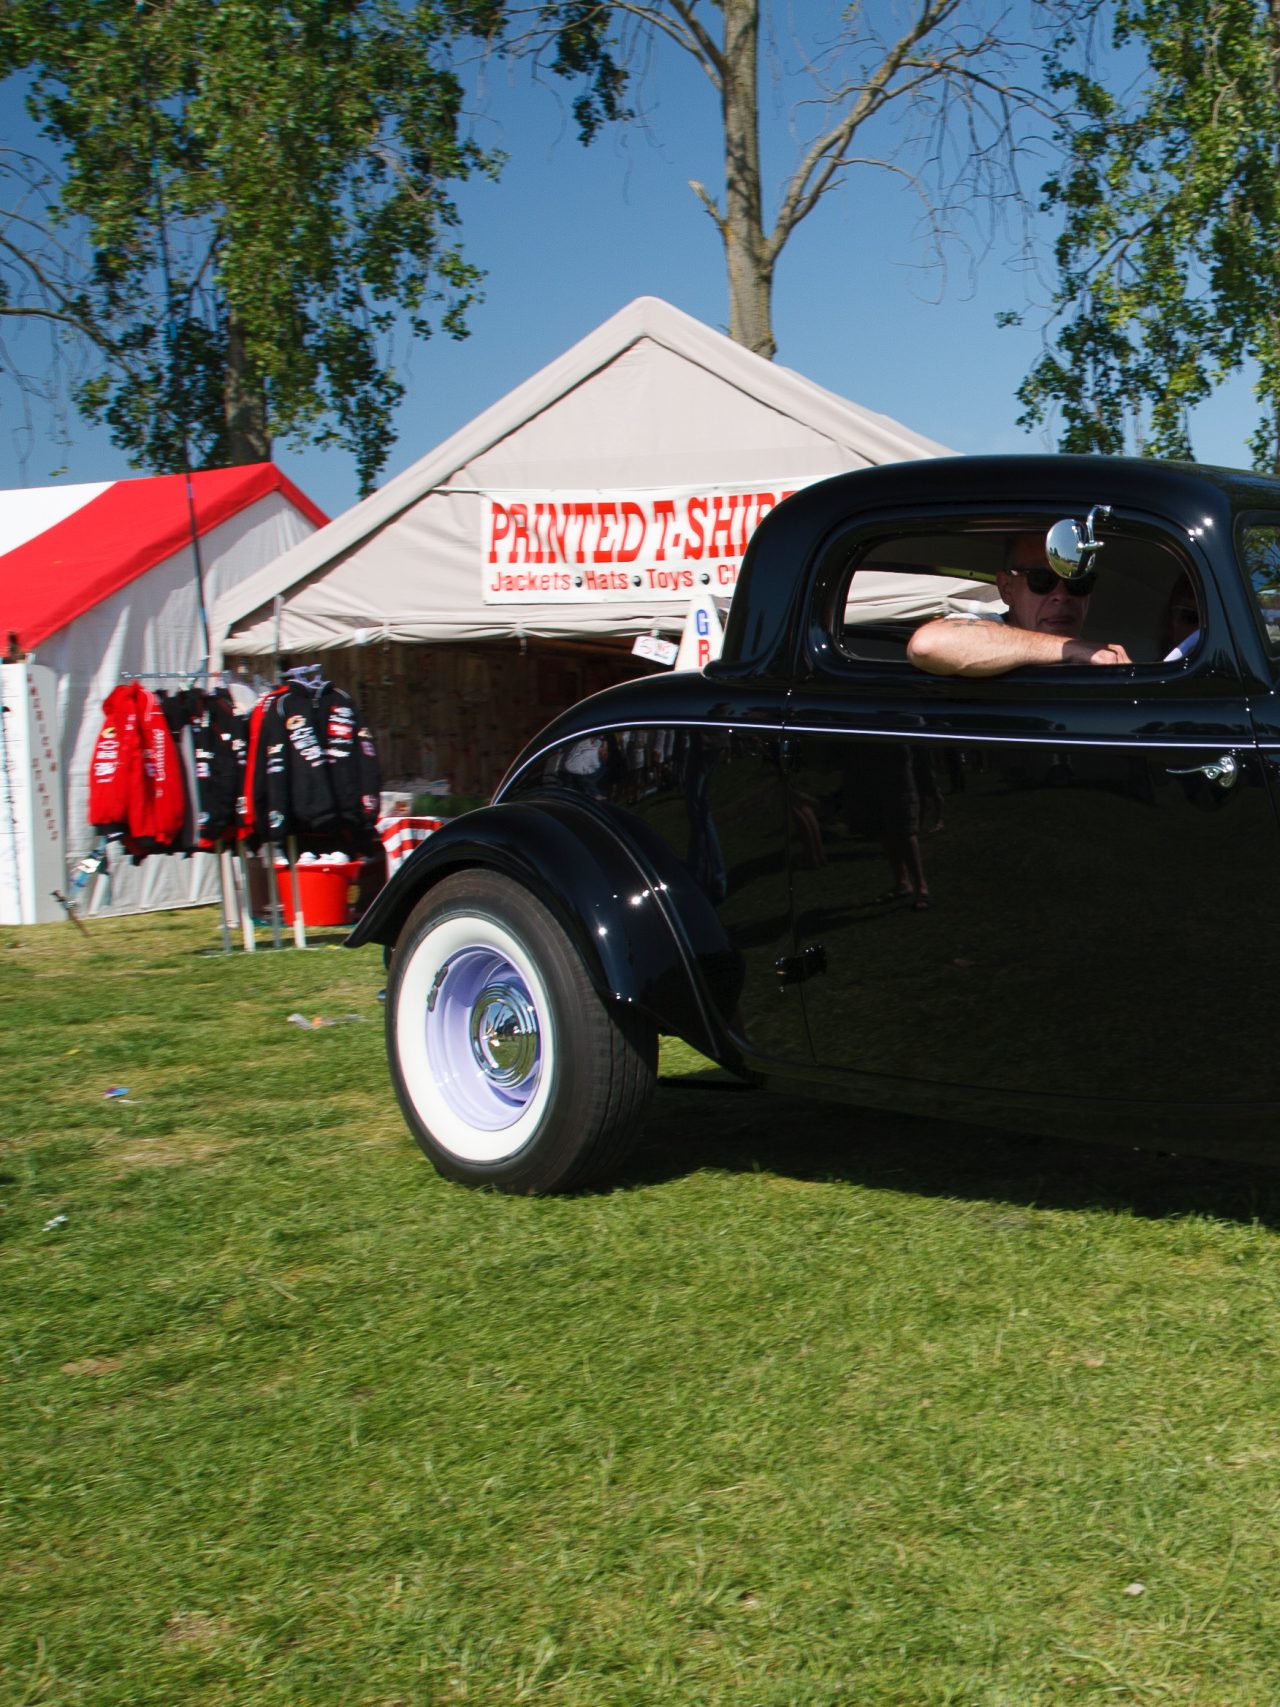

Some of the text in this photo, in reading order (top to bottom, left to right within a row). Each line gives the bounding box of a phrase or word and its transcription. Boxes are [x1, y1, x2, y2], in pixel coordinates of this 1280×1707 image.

[489, 489, 800, 564] PRINTED T-SHIR
[492, 571, 570, 592] Jackets
[585, 568, 628, 590] Hats
[646, 565, 694, 591] Toys
